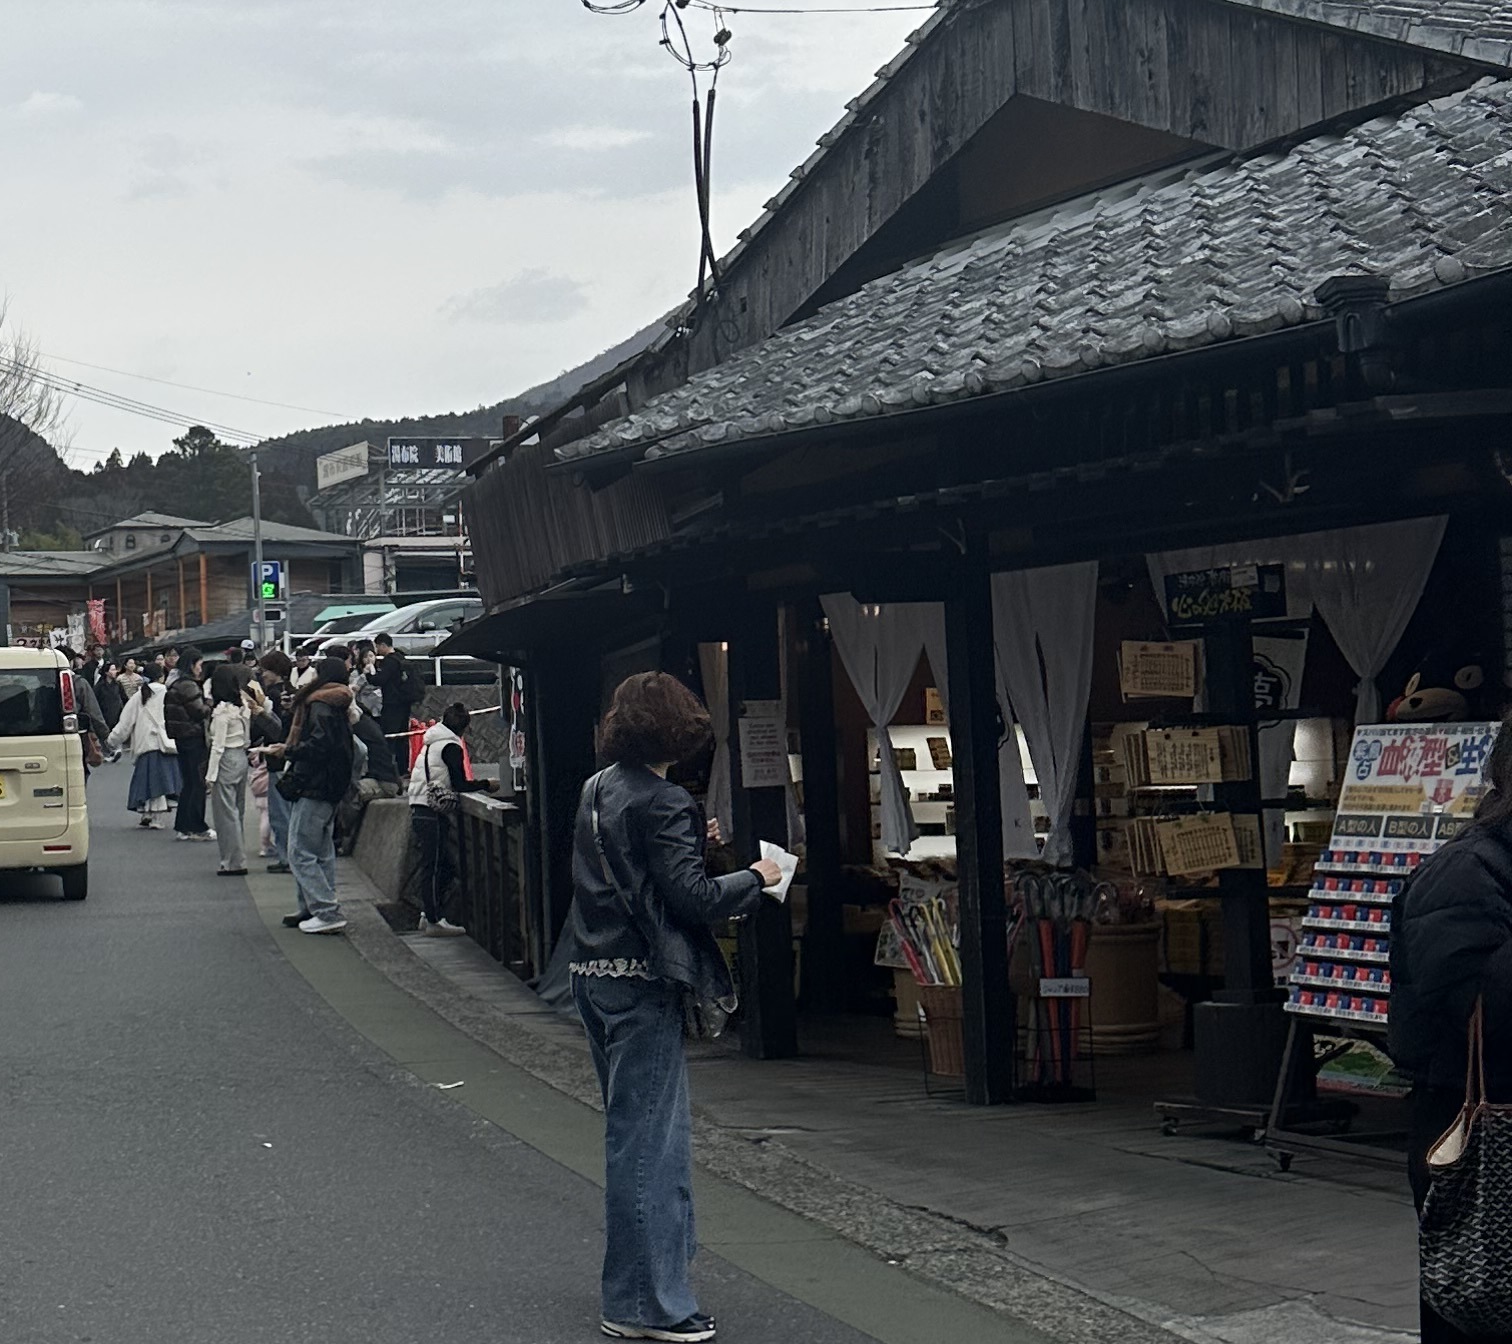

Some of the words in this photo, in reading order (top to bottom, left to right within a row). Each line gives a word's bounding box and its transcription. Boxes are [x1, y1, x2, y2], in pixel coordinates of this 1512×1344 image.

[261, 564, 274, 580] P
[1338, 819, 1377, 835] A型の人
[1388, 820, 1428, 836] B型の人
